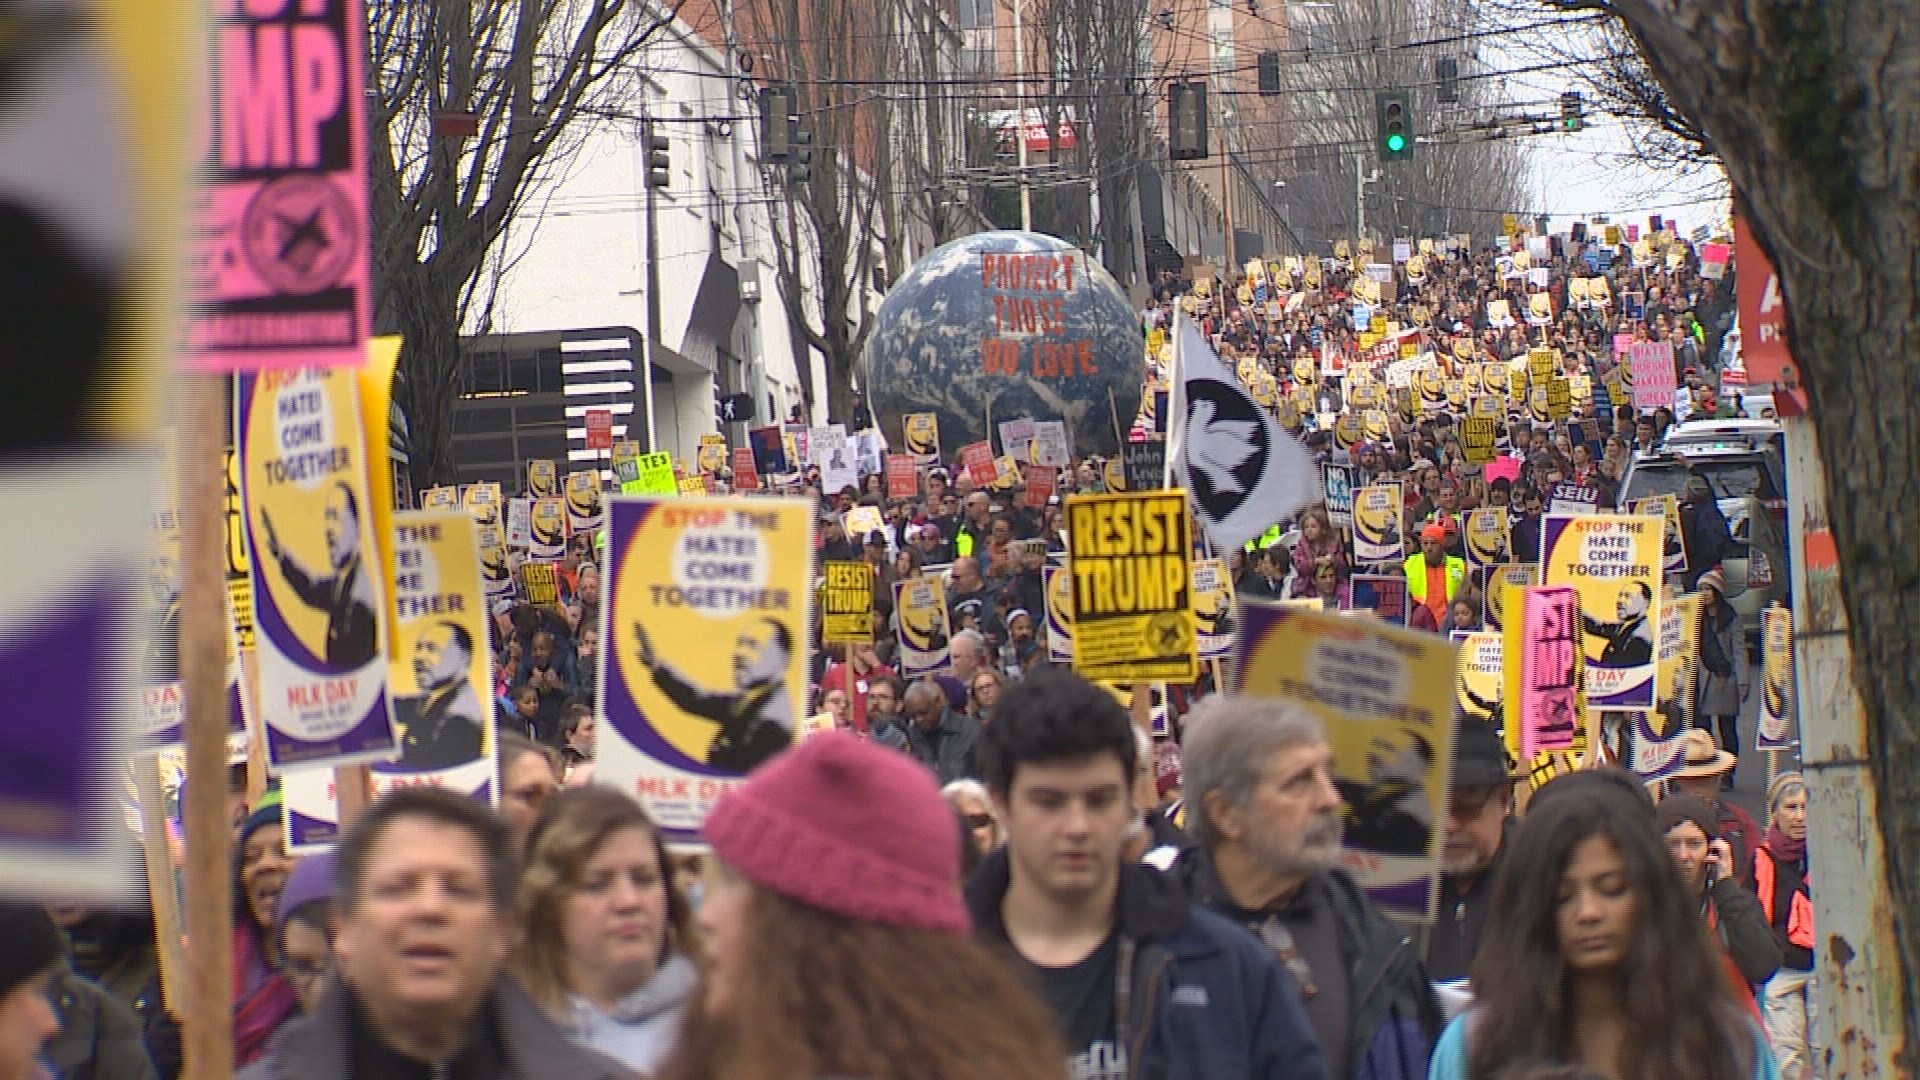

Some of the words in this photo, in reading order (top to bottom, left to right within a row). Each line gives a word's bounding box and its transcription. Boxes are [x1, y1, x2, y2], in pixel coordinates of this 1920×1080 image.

[982, 253, 1075, 292] PROTECT
[992, 295, 1066, 336] THOSE
[1031, 338, 1099, 378] LOVE
[277, 389, 324, 419] HATE!
[282, 419, 325, 449] COME
[1124, 443, 1161, 465] John
[1552, 484, 1599, 502] SEIU
[660, 506, 728, 530] STOP
[735, 510, 781, 531] THE
[1073, 501, 1183, 557] RESIST
[1575, 521, 1614, 534] STOP
[1616, 521, 1645, 534] THE
[684, 534, 759, 556] HATE!
[1587, 535, 1632, 548] HATE!
[1587, 549, 1629, 563] COME
[684, 560, 756, 582] COME
[827, 563, 870, 589] RESIST
[1567, 563, 1651, 578] TOGETHER
[1074, 555, 1185, 614] TRUMP
[649, 584, 792, 612] TOGETHER
[828, 589, 871, 614] TRUMP
[1471, 636, 1495, 646] STOP
[1596, 670, 1627, 683] DAY
[635, 776, 689, 800] MLK
